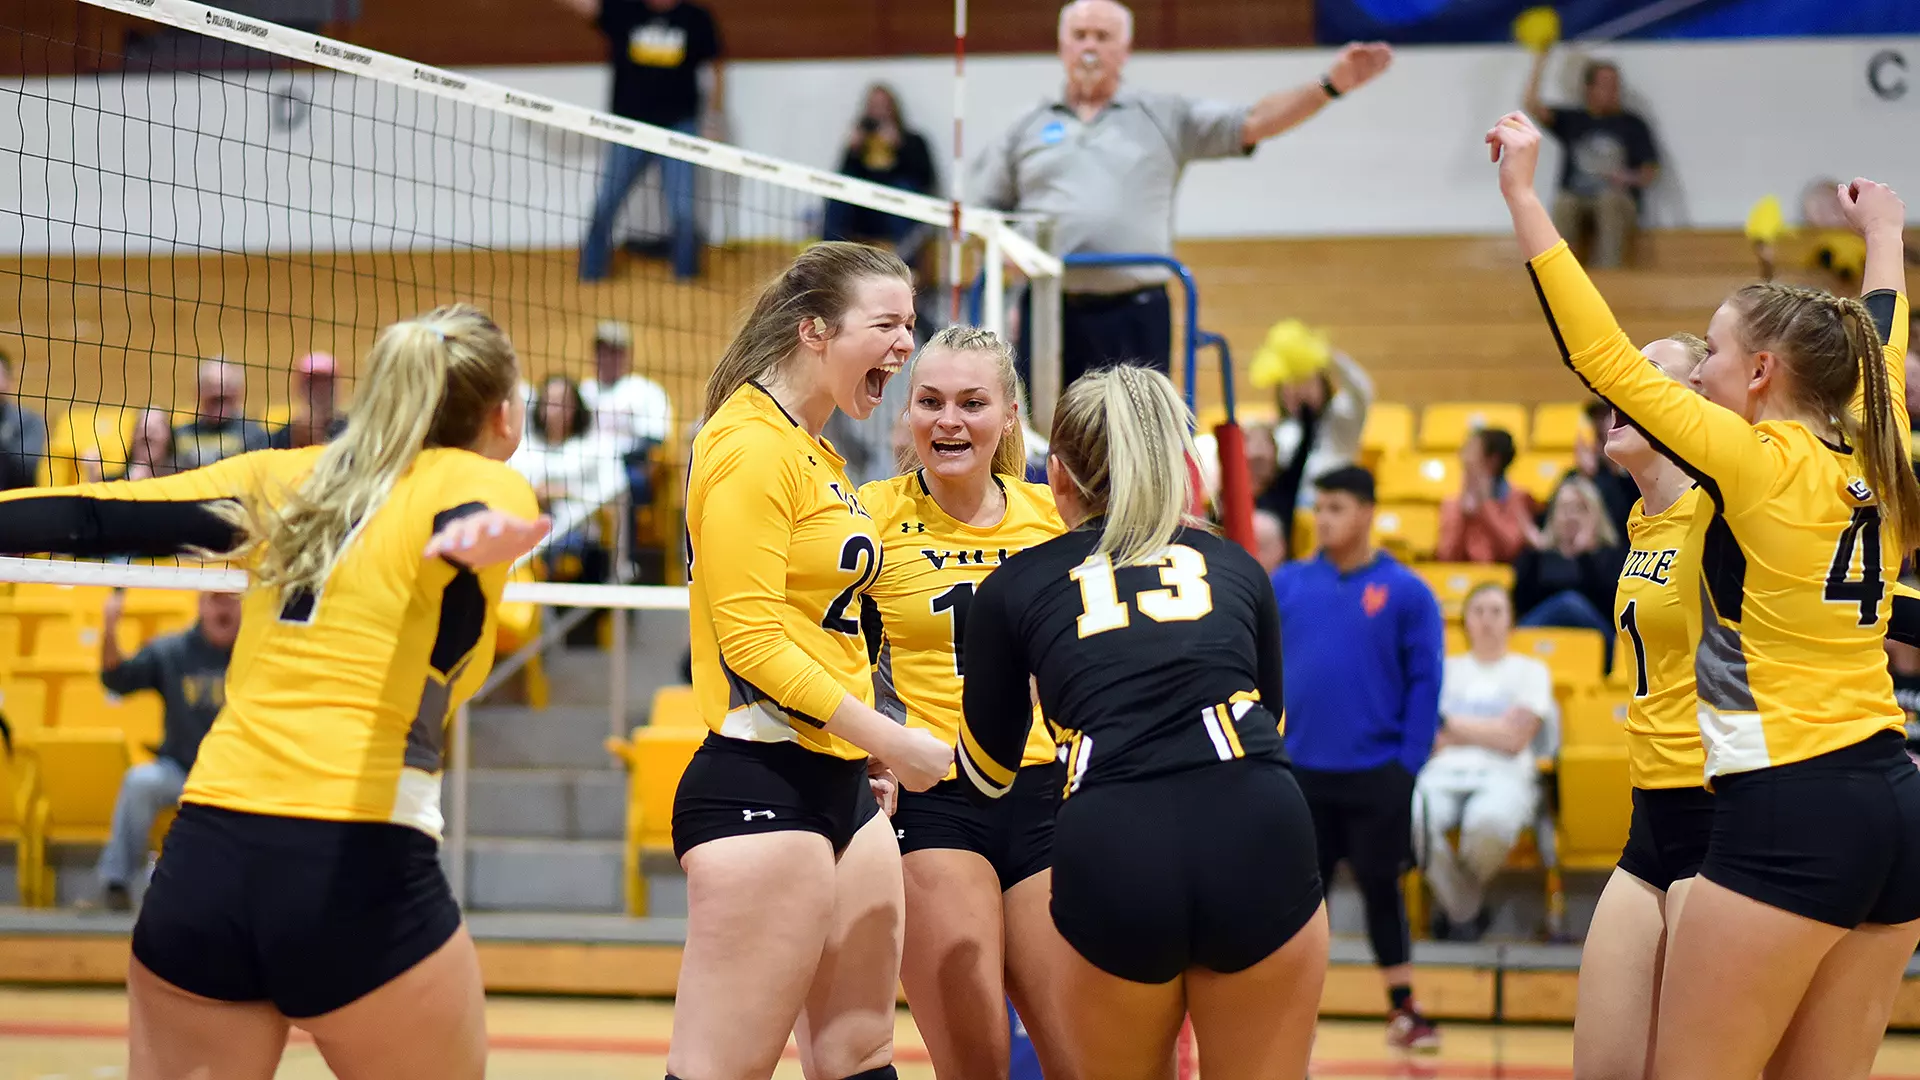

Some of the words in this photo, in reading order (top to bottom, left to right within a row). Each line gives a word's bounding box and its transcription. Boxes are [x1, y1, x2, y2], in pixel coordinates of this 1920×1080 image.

[212, 15, 237, 30] VOLLEYBALL
[237, 20, 269, 38] CHAMPIONSHIP
[1866, 49, 1909, 101] C
[1069, 544, 1214, 640] 13
[1822, 504, 1886, 628] 4
[1619, 598, 1649, 698] 1
